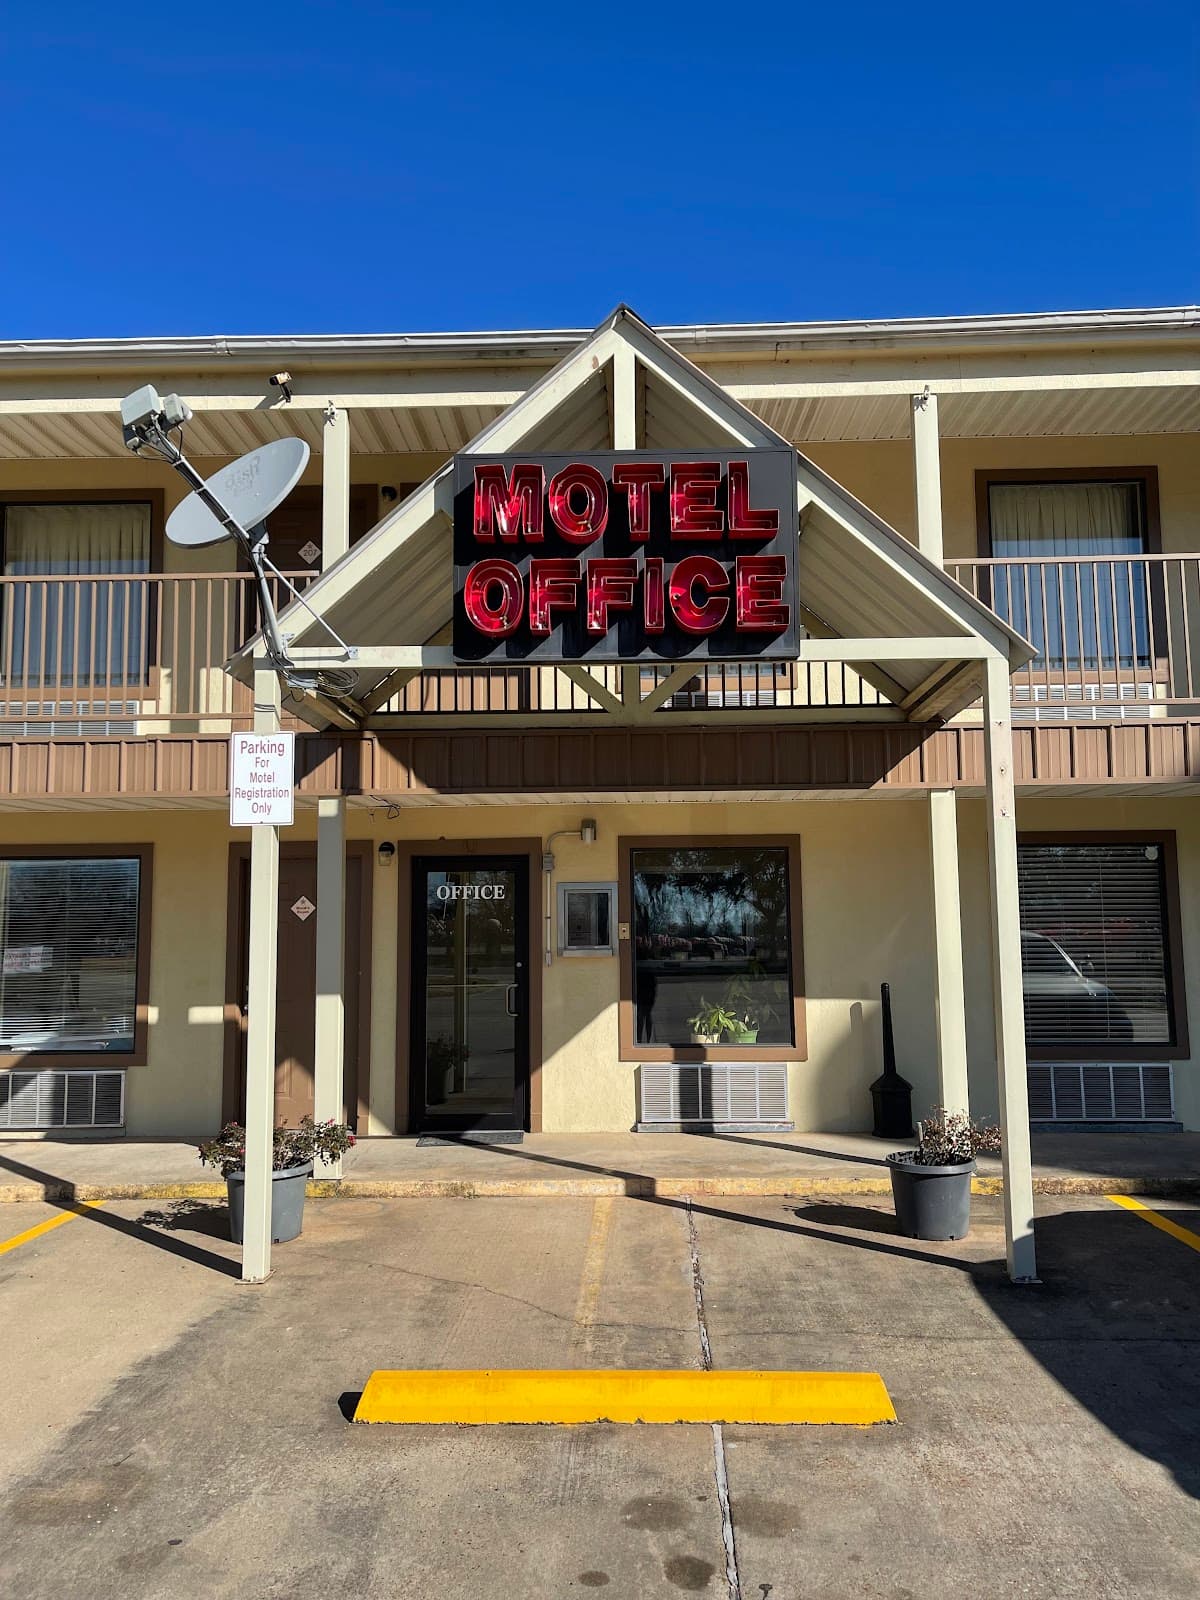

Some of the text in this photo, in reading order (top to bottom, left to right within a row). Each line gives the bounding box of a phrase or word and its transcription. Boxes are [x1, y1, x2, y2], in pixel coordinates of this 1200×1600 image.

[473, 461, 780, 544] MOTEL
[303, 548, 318, 557] 207
[464, 555, 791, 638] OFFICE
[240, 740, 285, 757] Parking
[255, 757, 270, 768] For
[249, 772, 275, 783] Motel
[234, 787, 290, 801] Registration
[251, 802, 272, 816] Only
[436, 885, 505, 900] OFFICE
